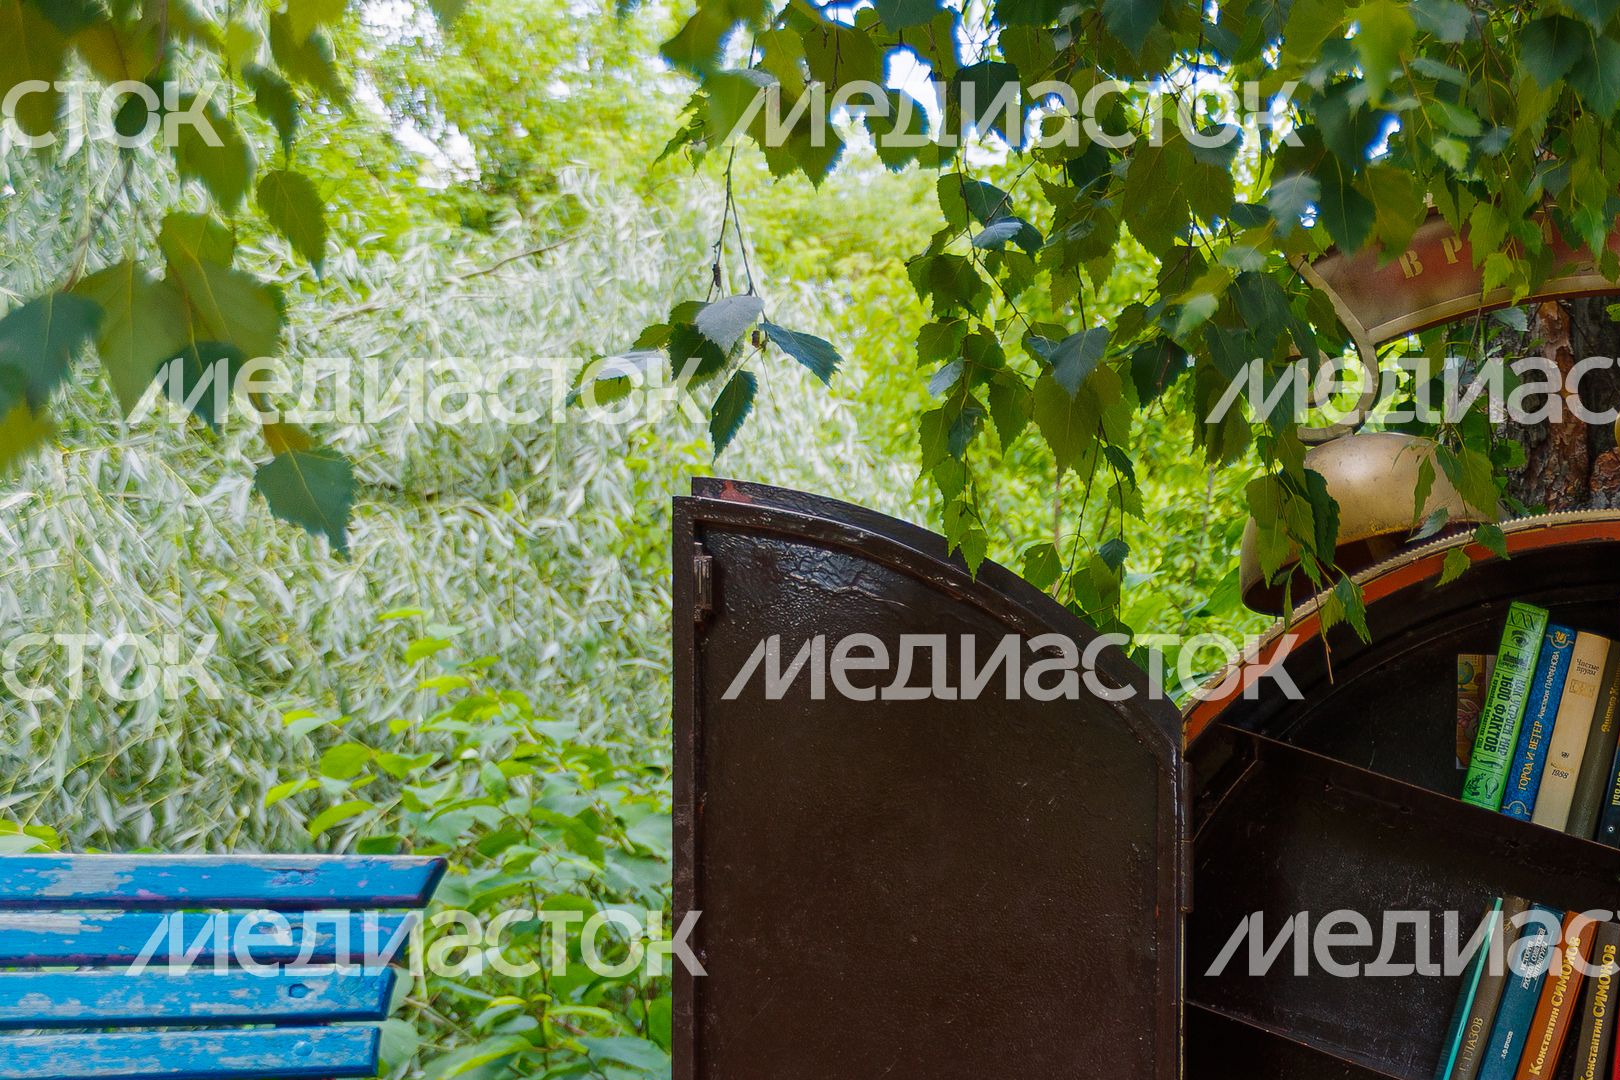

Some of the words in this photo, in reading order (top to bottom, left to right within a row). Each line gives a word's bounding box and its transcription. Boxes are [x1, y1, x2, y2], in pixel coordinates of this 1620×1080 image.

[1576, 658, 1600, 671] Чистые
[1576, 666, 1597, 676] пруды
[1498, 674, 1514, 701] 1600
[1513, 677, 1526, 695] КАК
[1483, 702, 1507, 753] ФАКТОВ
[1529, 720, 1544, 751] ВЕТЕР
[1497, 733, 1511, 756] МИР
[1525, 751, 1535, 761] И
[1518, 762, 1534, 791] ГОРОД
[1551, 768, 1569, 780] 1988
[1592, 944, 1618, 1018] СИМОНОВ
[1529, 1007, 1560, 1076] Константин
[1552, 935, 1581, 1007] СИМОНОВ
[1463, 1016, 1484, 1060] ГЛАЗОВ
